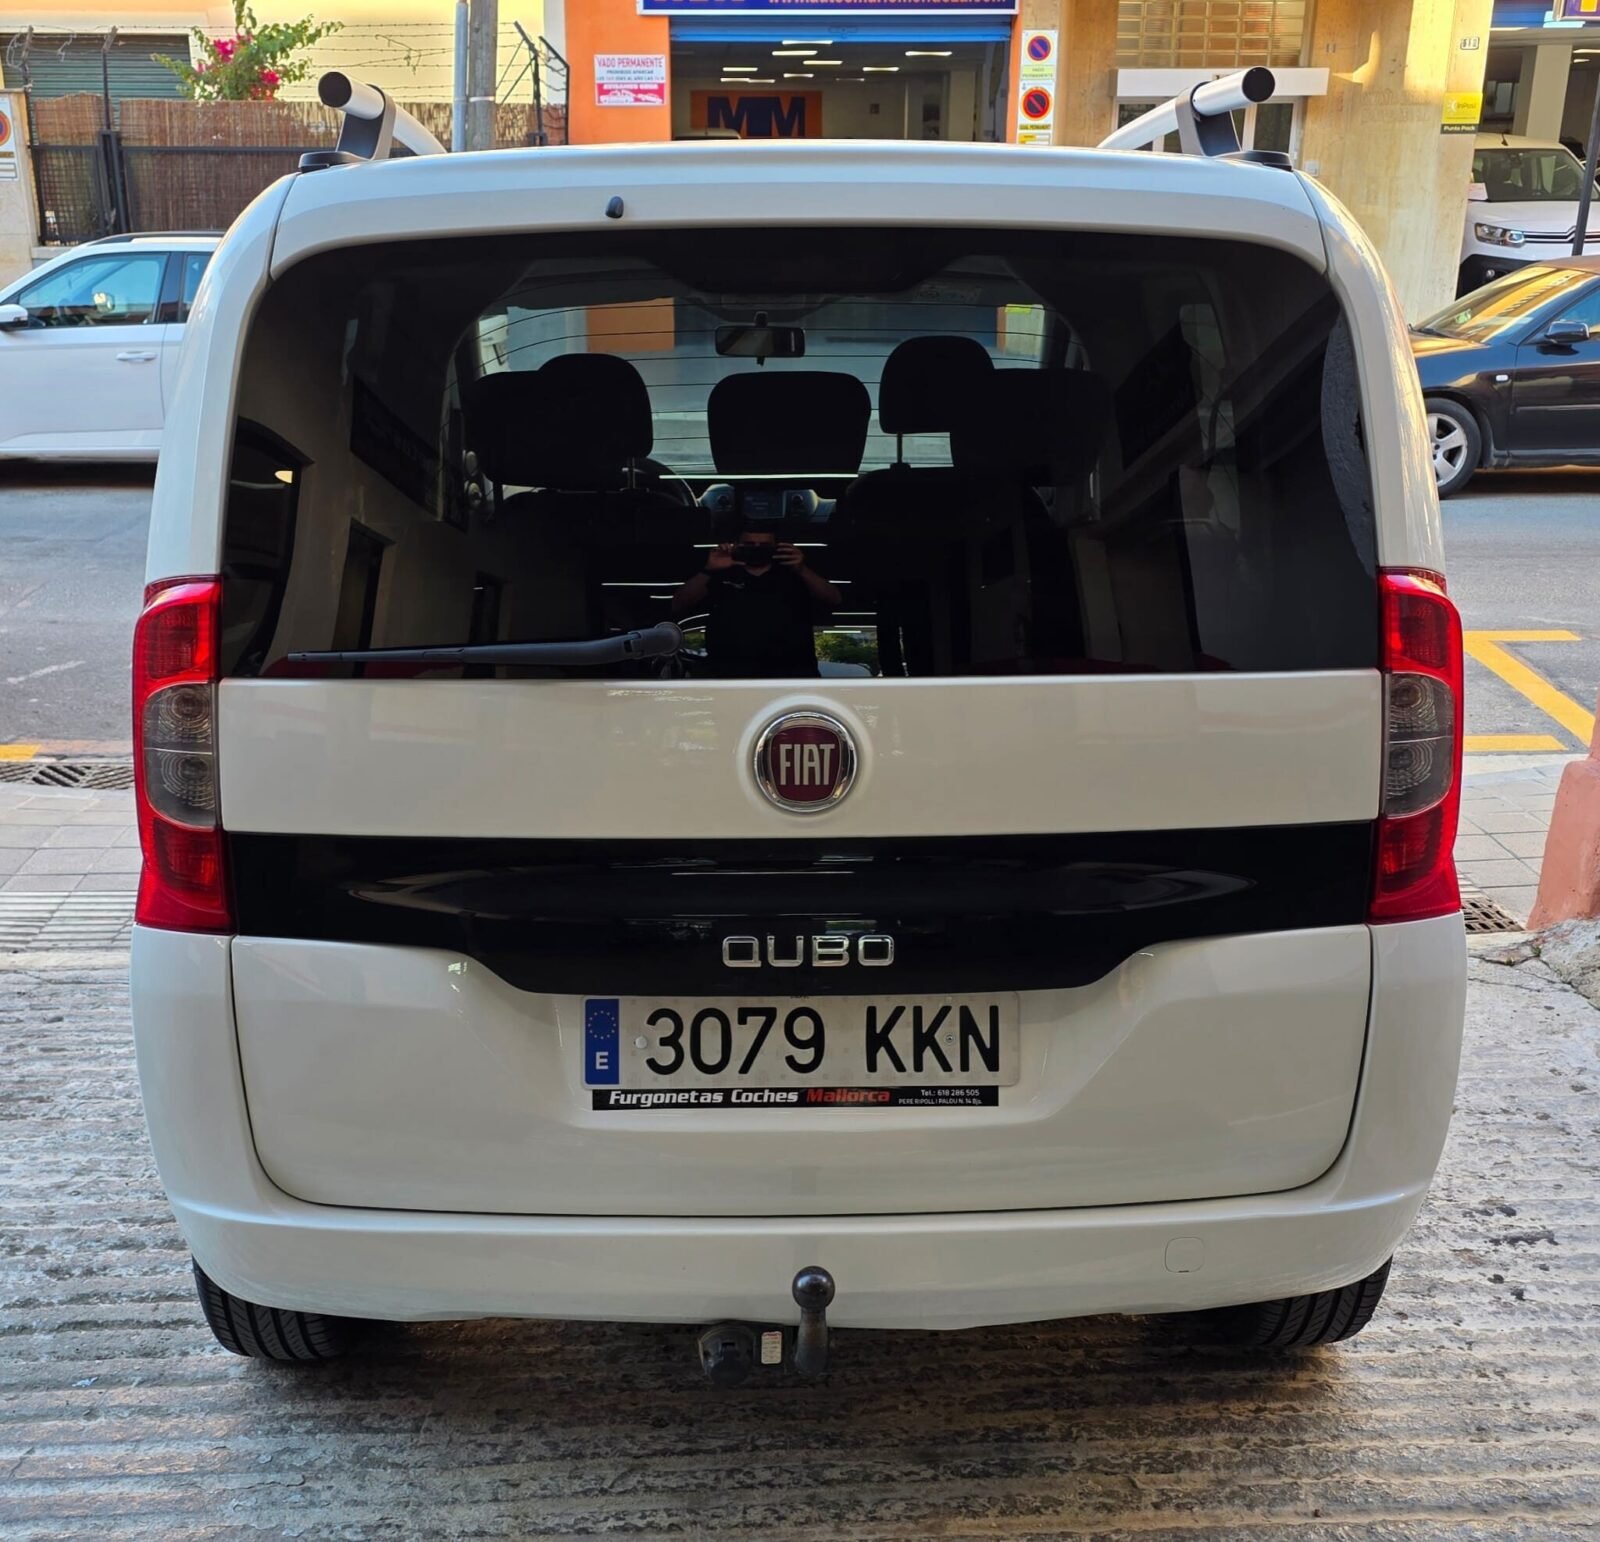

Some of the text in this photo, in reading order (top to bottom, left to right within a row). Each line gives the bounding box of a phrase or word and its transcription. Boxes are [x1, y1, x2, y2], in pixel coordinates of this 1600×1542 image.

[597, 57, 663, 68] VADO PERMANENTE
[779, 743, 835, 786] FIAT
[722, 934, 895, 968] QUBO
[646, 1005, 999, 1075] 3079 KKN
[595, 1051, 609, 1070] E
[609, 1088, 891, 1107] Furgonetas Coches Mallorca
